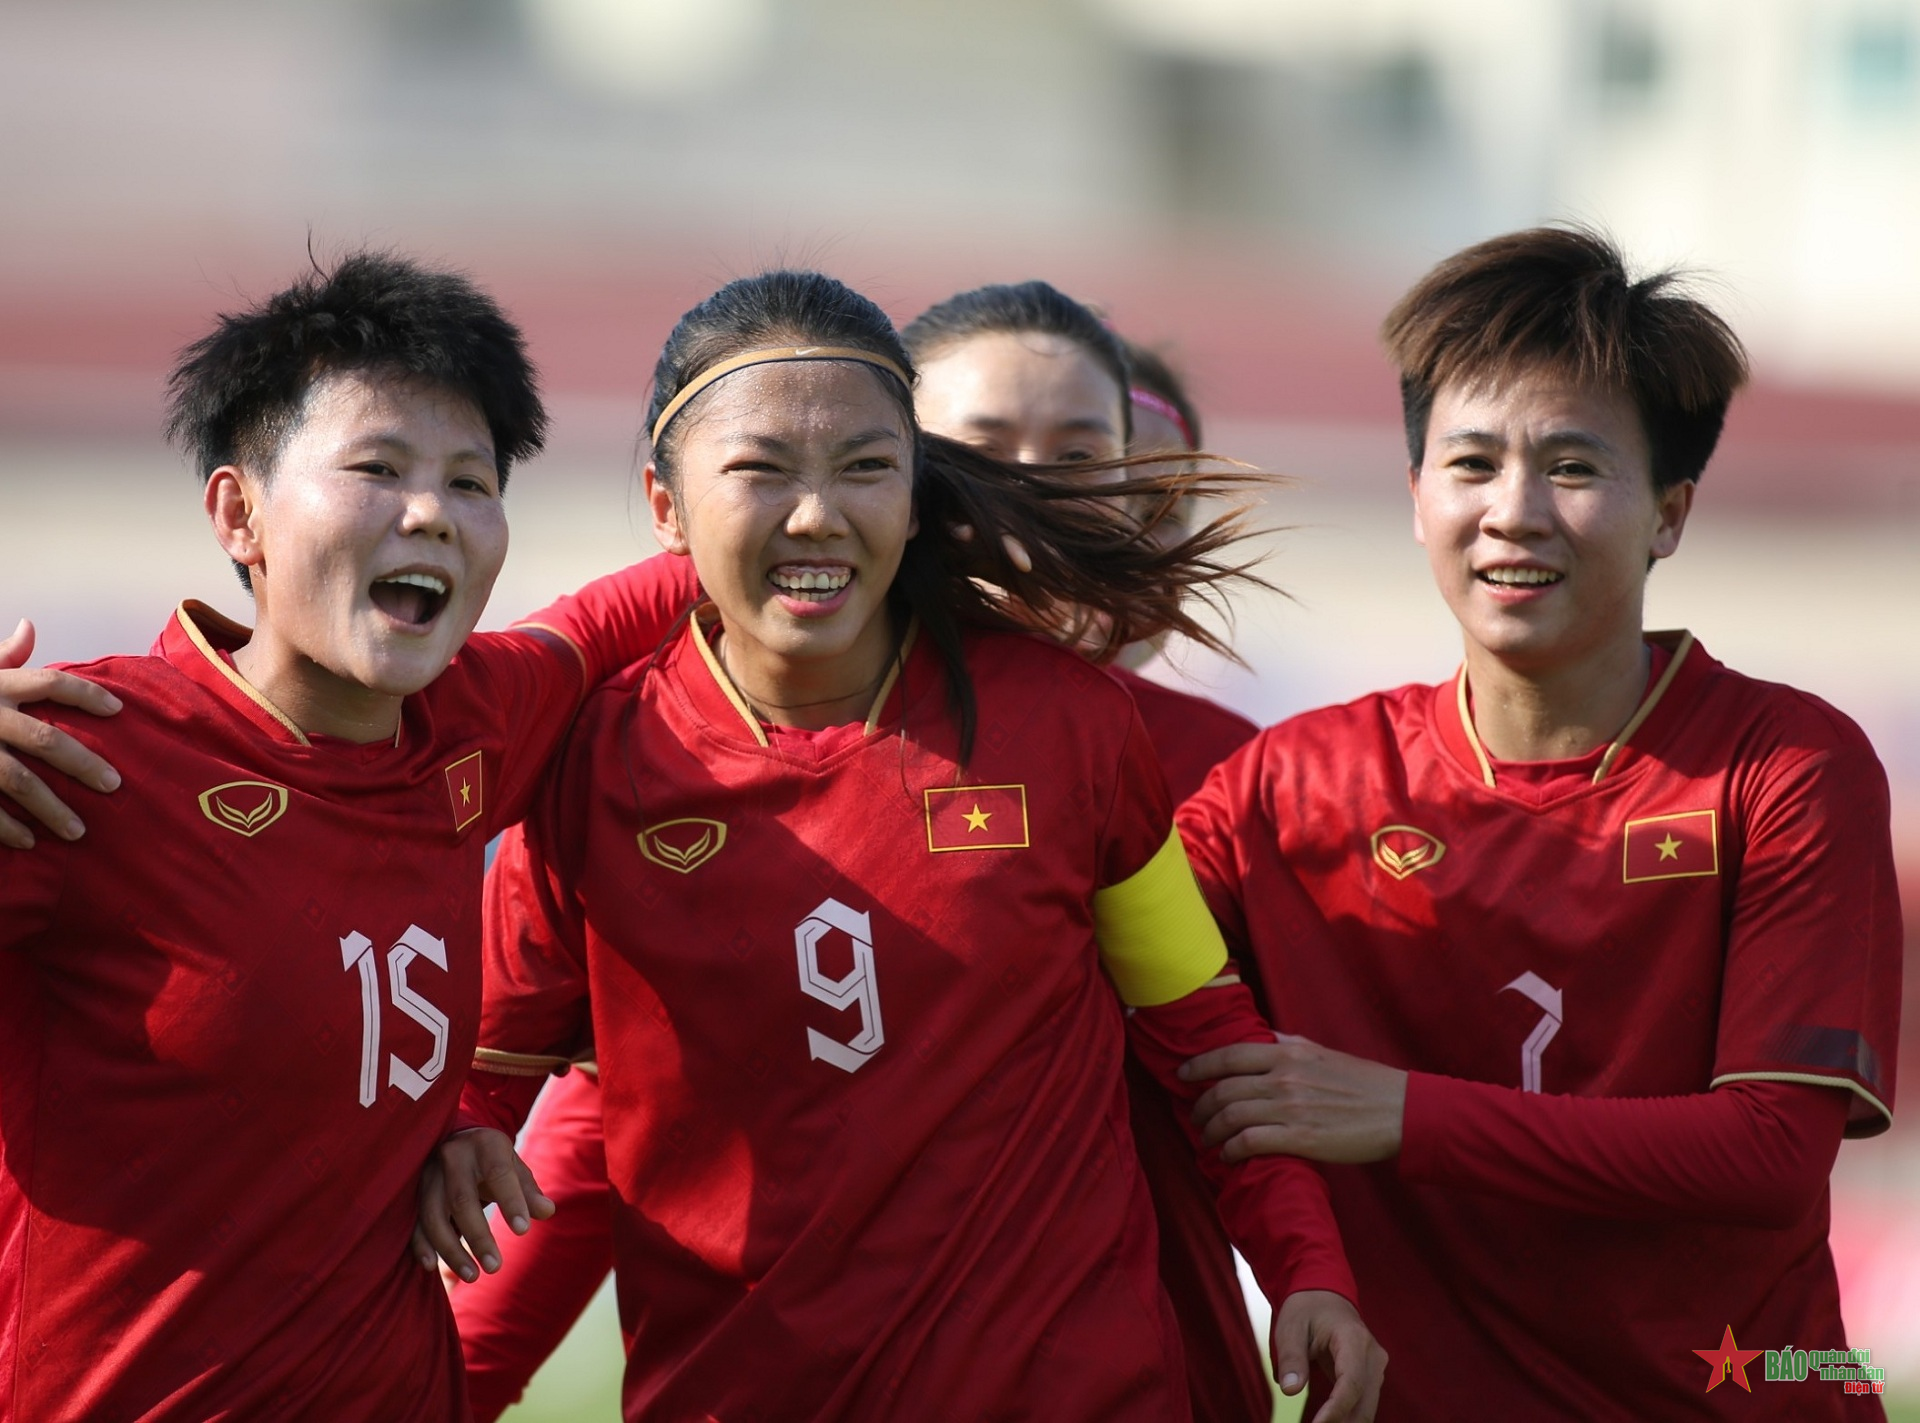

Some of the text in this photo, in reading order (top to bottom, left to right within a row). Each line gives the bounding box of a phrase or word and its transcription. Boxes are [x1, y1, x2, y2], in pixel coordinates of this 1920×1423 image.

[339, 923, 449, 1108] 15
[794, 897, 885, 1073] 9
[1495, 970, 1563, 1094] 7
